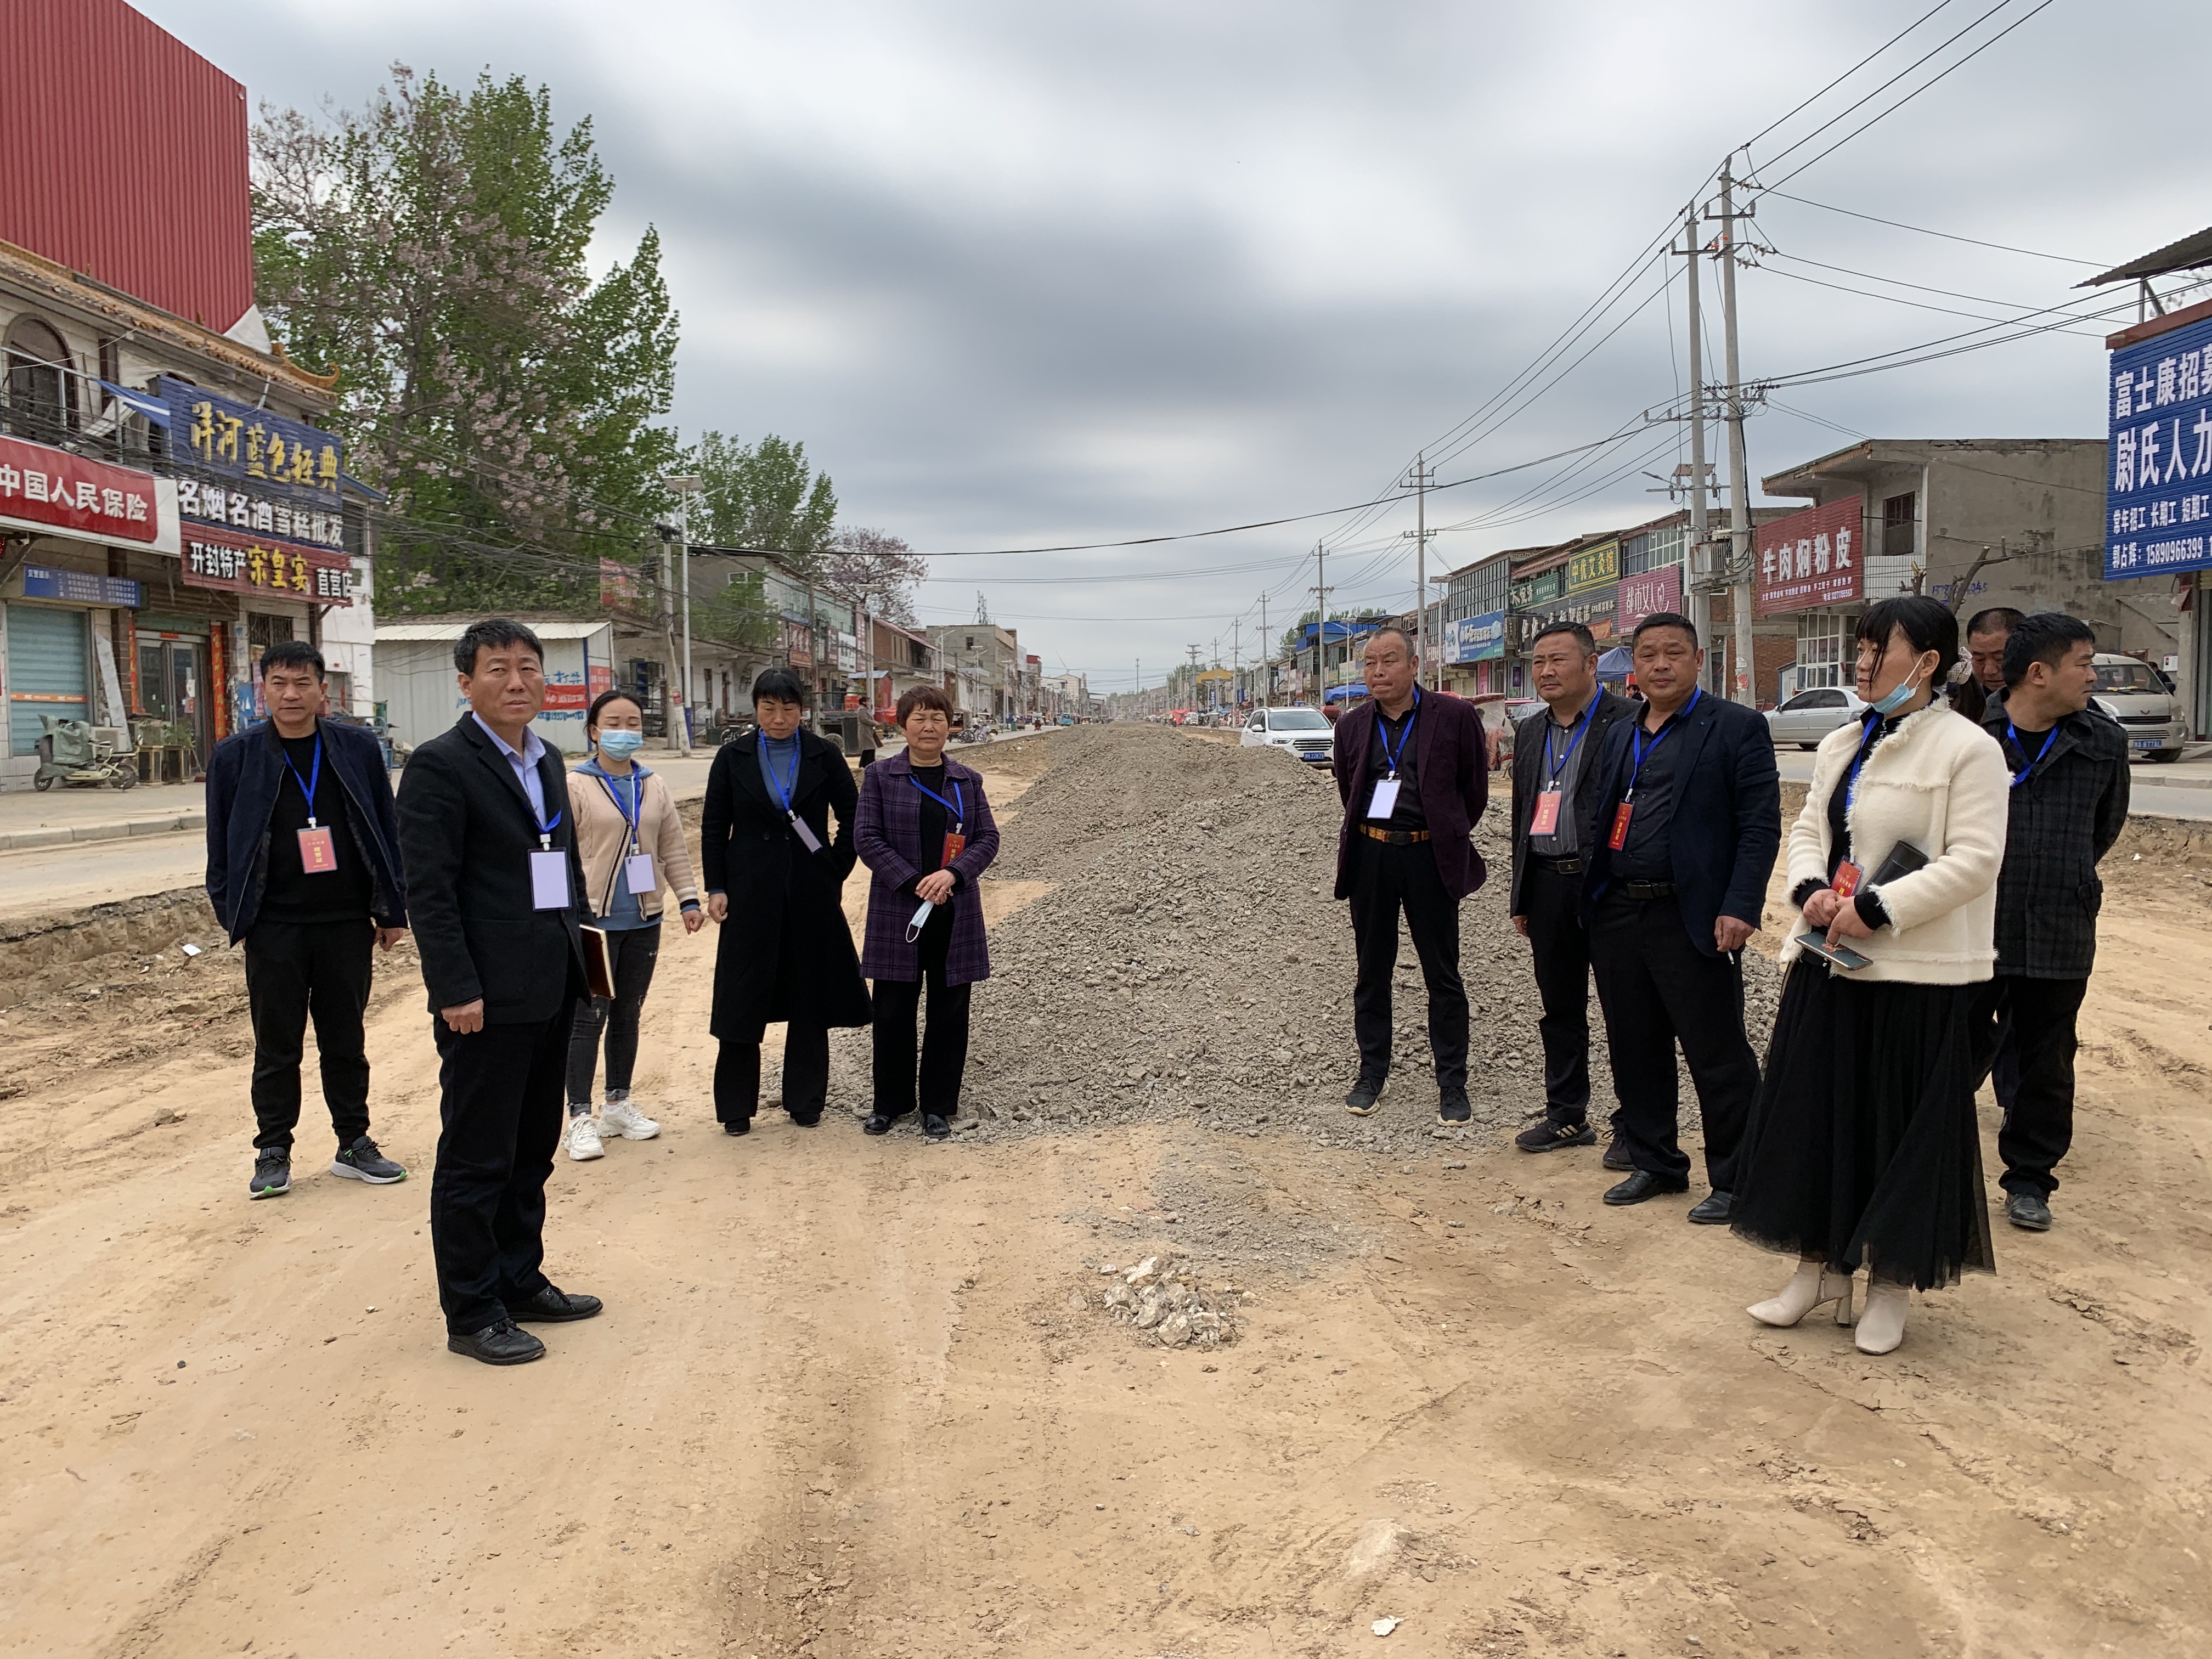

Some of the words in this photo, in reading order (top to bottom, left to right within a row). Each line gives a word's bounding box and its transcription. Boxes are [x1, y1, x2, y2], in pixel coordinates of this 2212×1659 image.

[2115, 408, 2212, 492] 尉氏人力
[0, 464, 148, 521] 中国人民保险
[178, 479, 344, 547] 名烟名酒雪糕批发
[2150, 500, 2176, 528] 长期工
[2181, 494, 2210, 523] 短期工
[190, 541, 246, 579] 开封特产
[247, 544, 309, 591] 宋皇宴
[317, 567, 353, 599] 直营店
[1763, 526, 1853, 585] 牛肉焖粉皮
[2146, 537, 2203, 565] 15890966399
